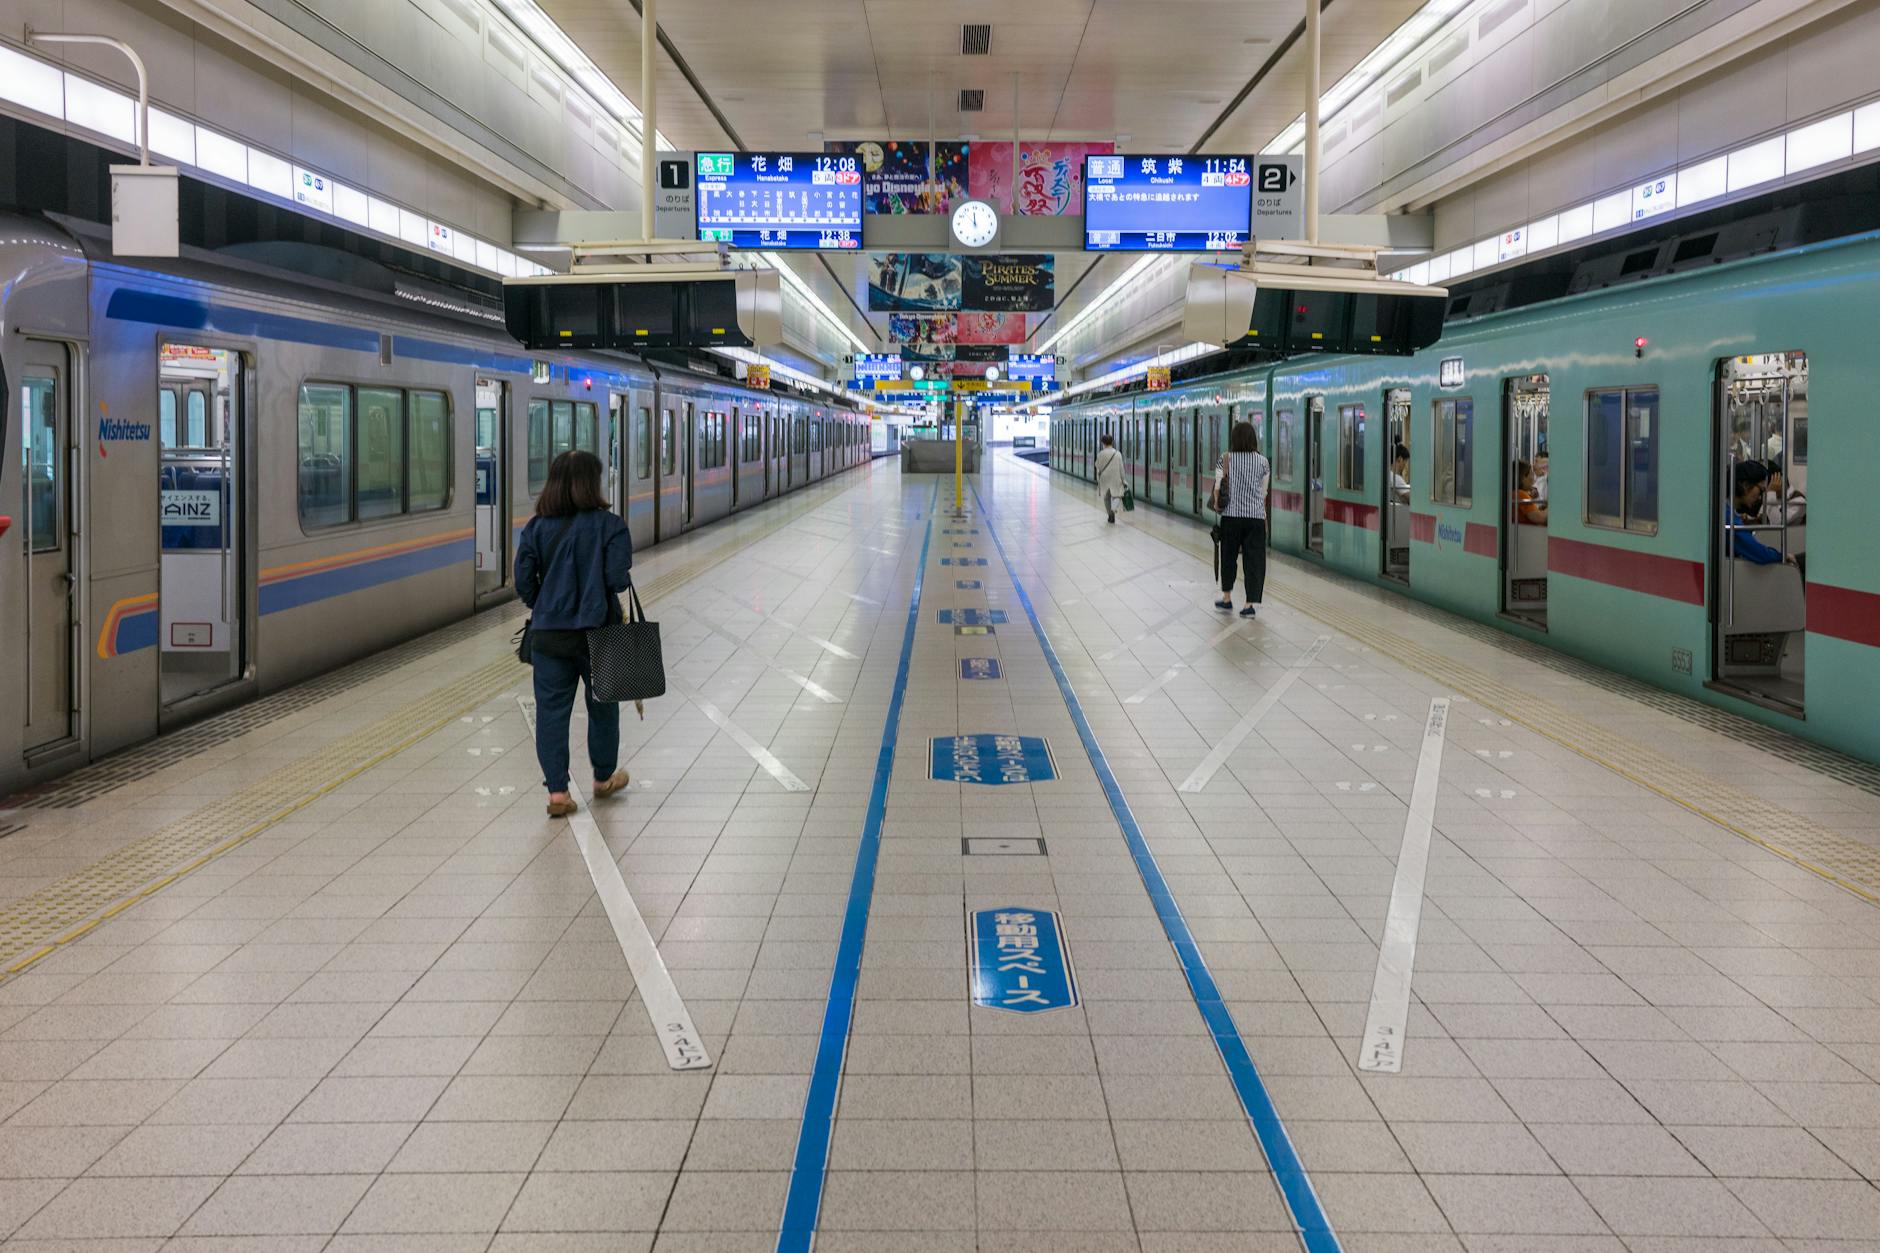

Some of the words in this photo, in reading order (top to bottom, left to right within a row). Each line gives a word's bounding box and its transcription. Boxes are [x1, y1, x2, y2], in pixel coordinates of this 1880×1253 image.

[701, 156, 731, 173] 急行
[751, 155, 793, 172] 花畑
[815, 157, 856, 172] 12:08
[1091, 160, 1121, 175] 普通
[1141, 158, 1182, 175] 筑紫
[1206, 159, 1245, 173] 11:54
[670, 164, 678, 186] 1
[1264, 168, 1281, 189] 2
[665, 194, 690, 204] のりば
[1257, 198, 1281, 207] のりば
[1257, 209, 1292, 217] Departures
[760, 228, 787, 240] 花畑
[820, 229, 850, 241] 12:38
[1145, 231, 1176, 243] 二日市
[1208, 231, 1237, 242] 12:02
[985, 273, 1038, 286] SUMMER
[1041, 381, 1049, 391] 2
[98, 416, 151, 442] Nishitetsu
[164, 503, 211, 516] AINZ
